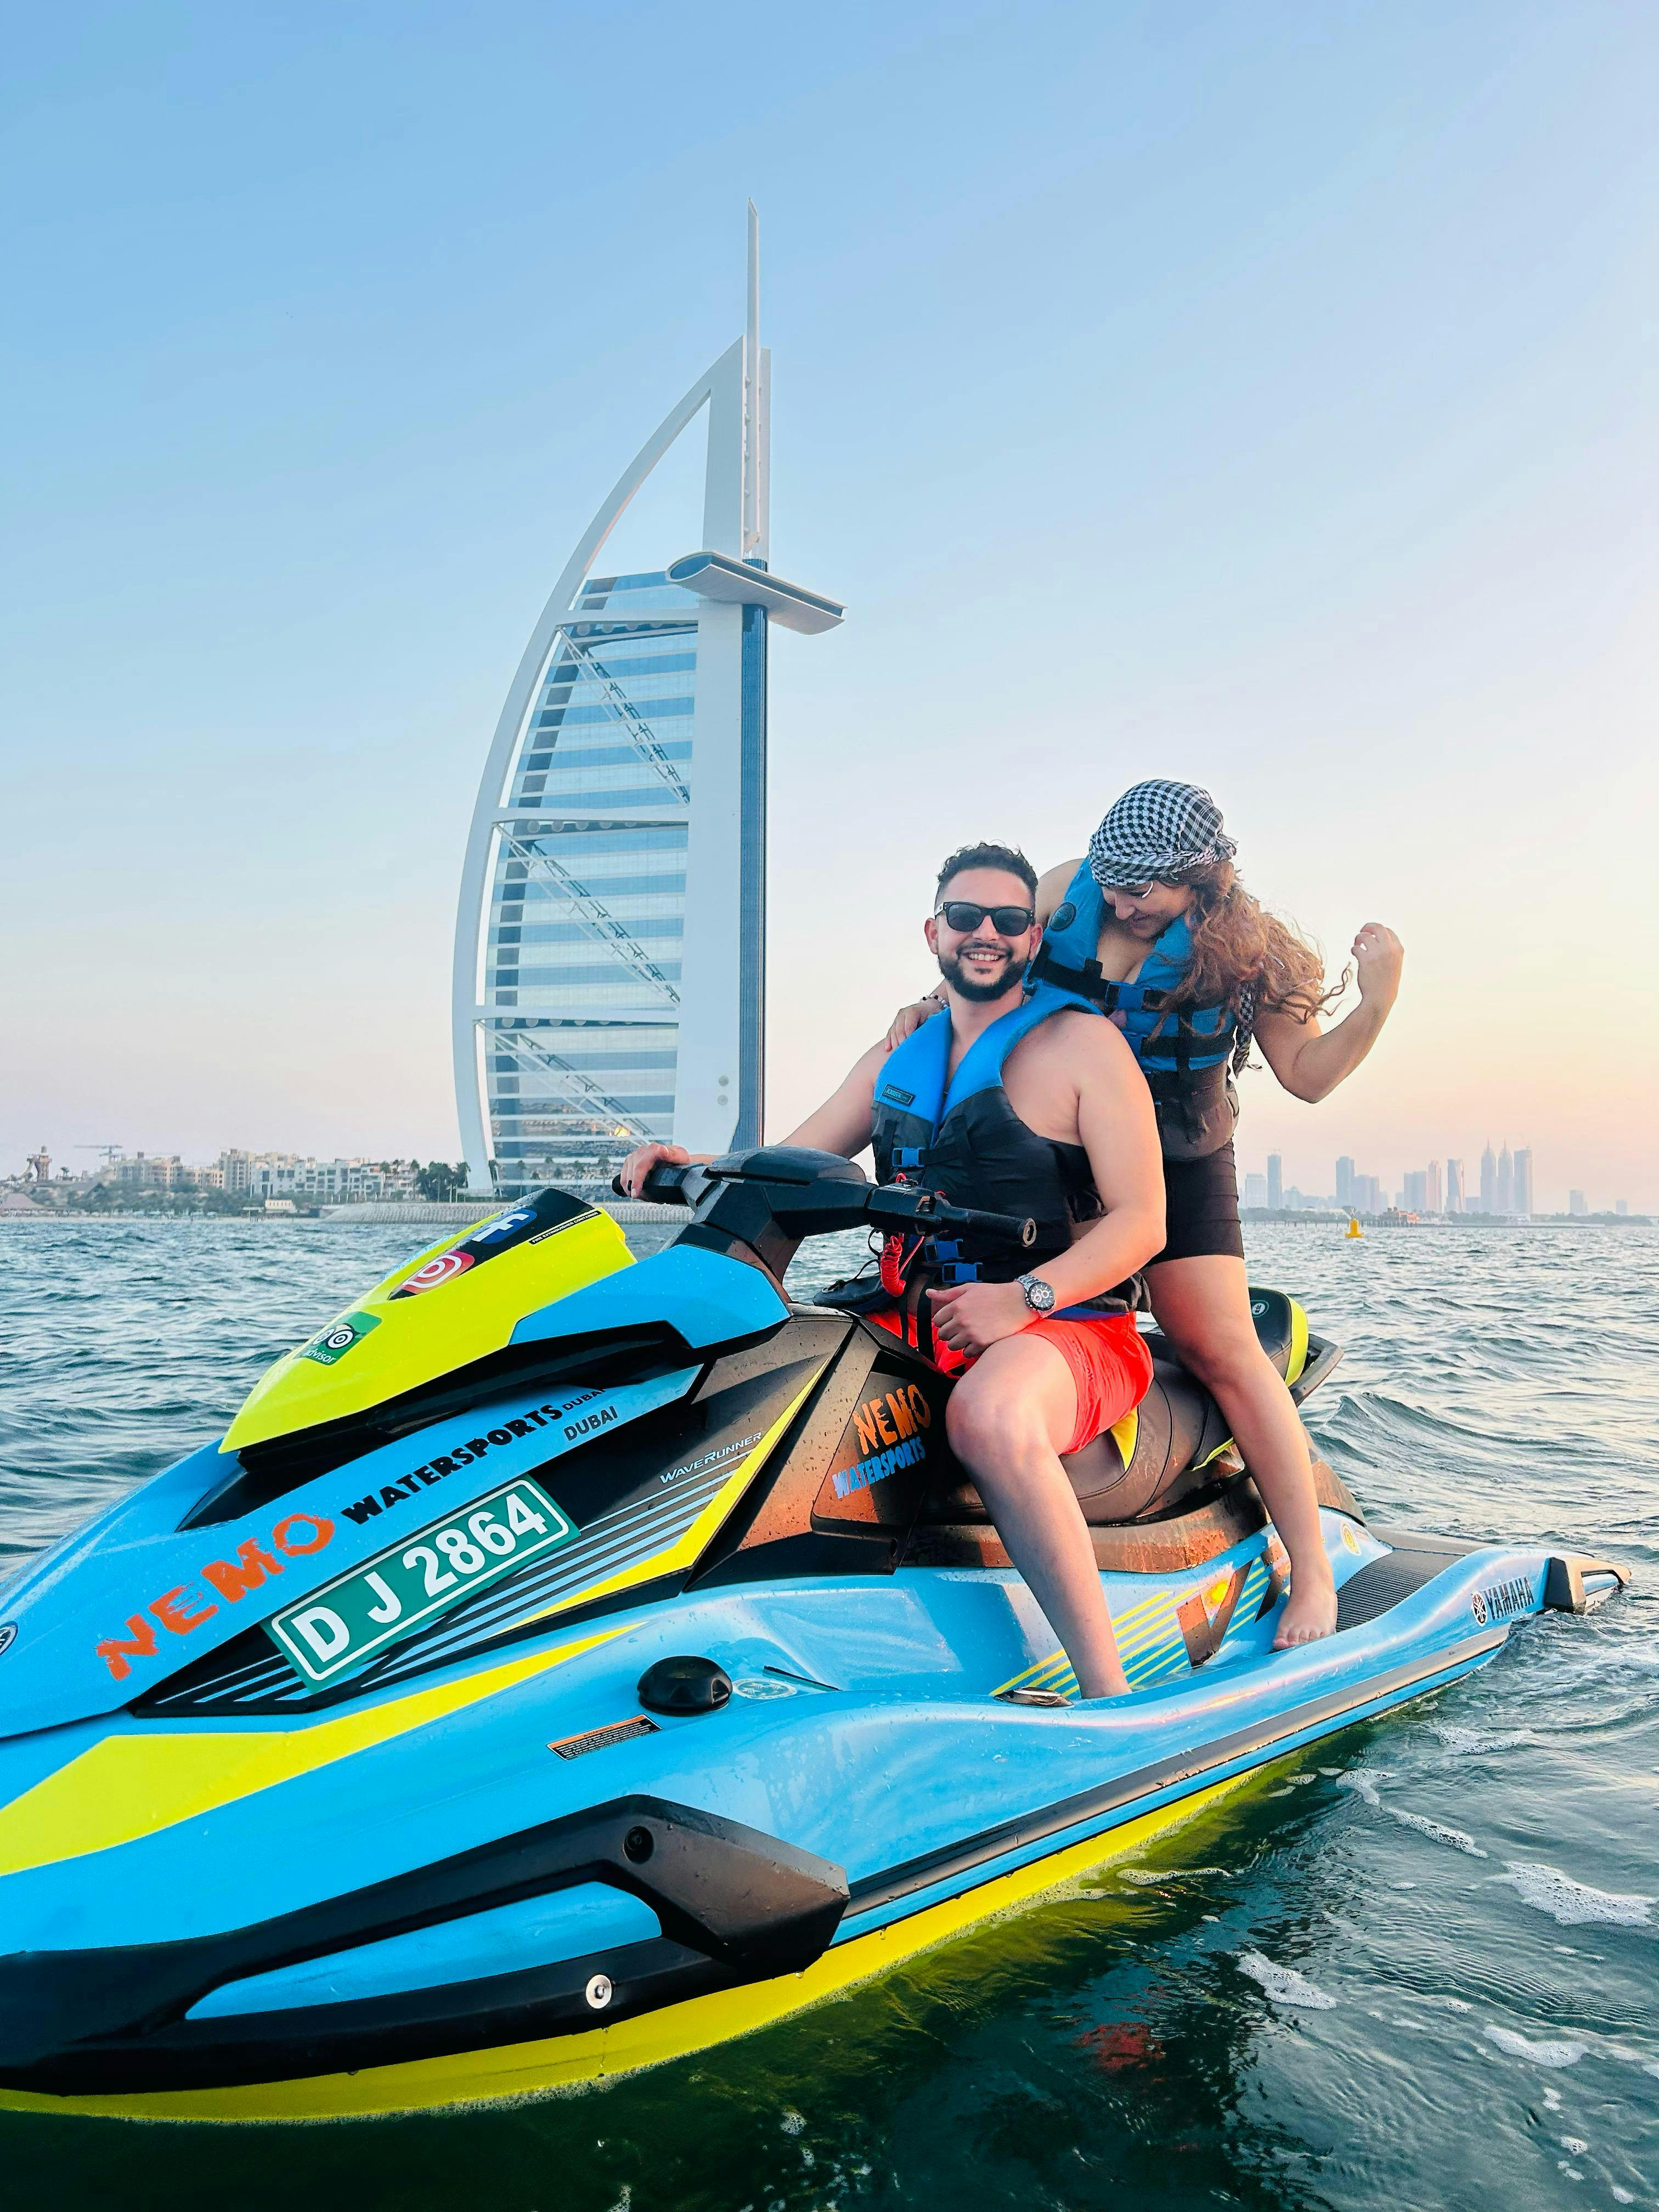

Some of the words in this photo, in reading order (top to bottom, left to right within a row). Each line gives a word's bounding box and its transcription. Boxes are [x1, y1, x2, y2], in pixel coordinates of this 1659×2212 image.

[563, 1406, 618, 1441] DUBAI
[853, 1384, 931, 1455] NEMO
[832, 1436, 926, 1499] WATERSPORTS
[96, 1513, 335, 1680] NEMO
[341, 1404, 563, 1525] WATERSPORTS
[291, 1606, 350, 1662] D
[364, 1572, 401, 1624] J
[403, 1493, 548, 1596] 2864
[1483, 1577, 1534, 1621] YAMAHA
